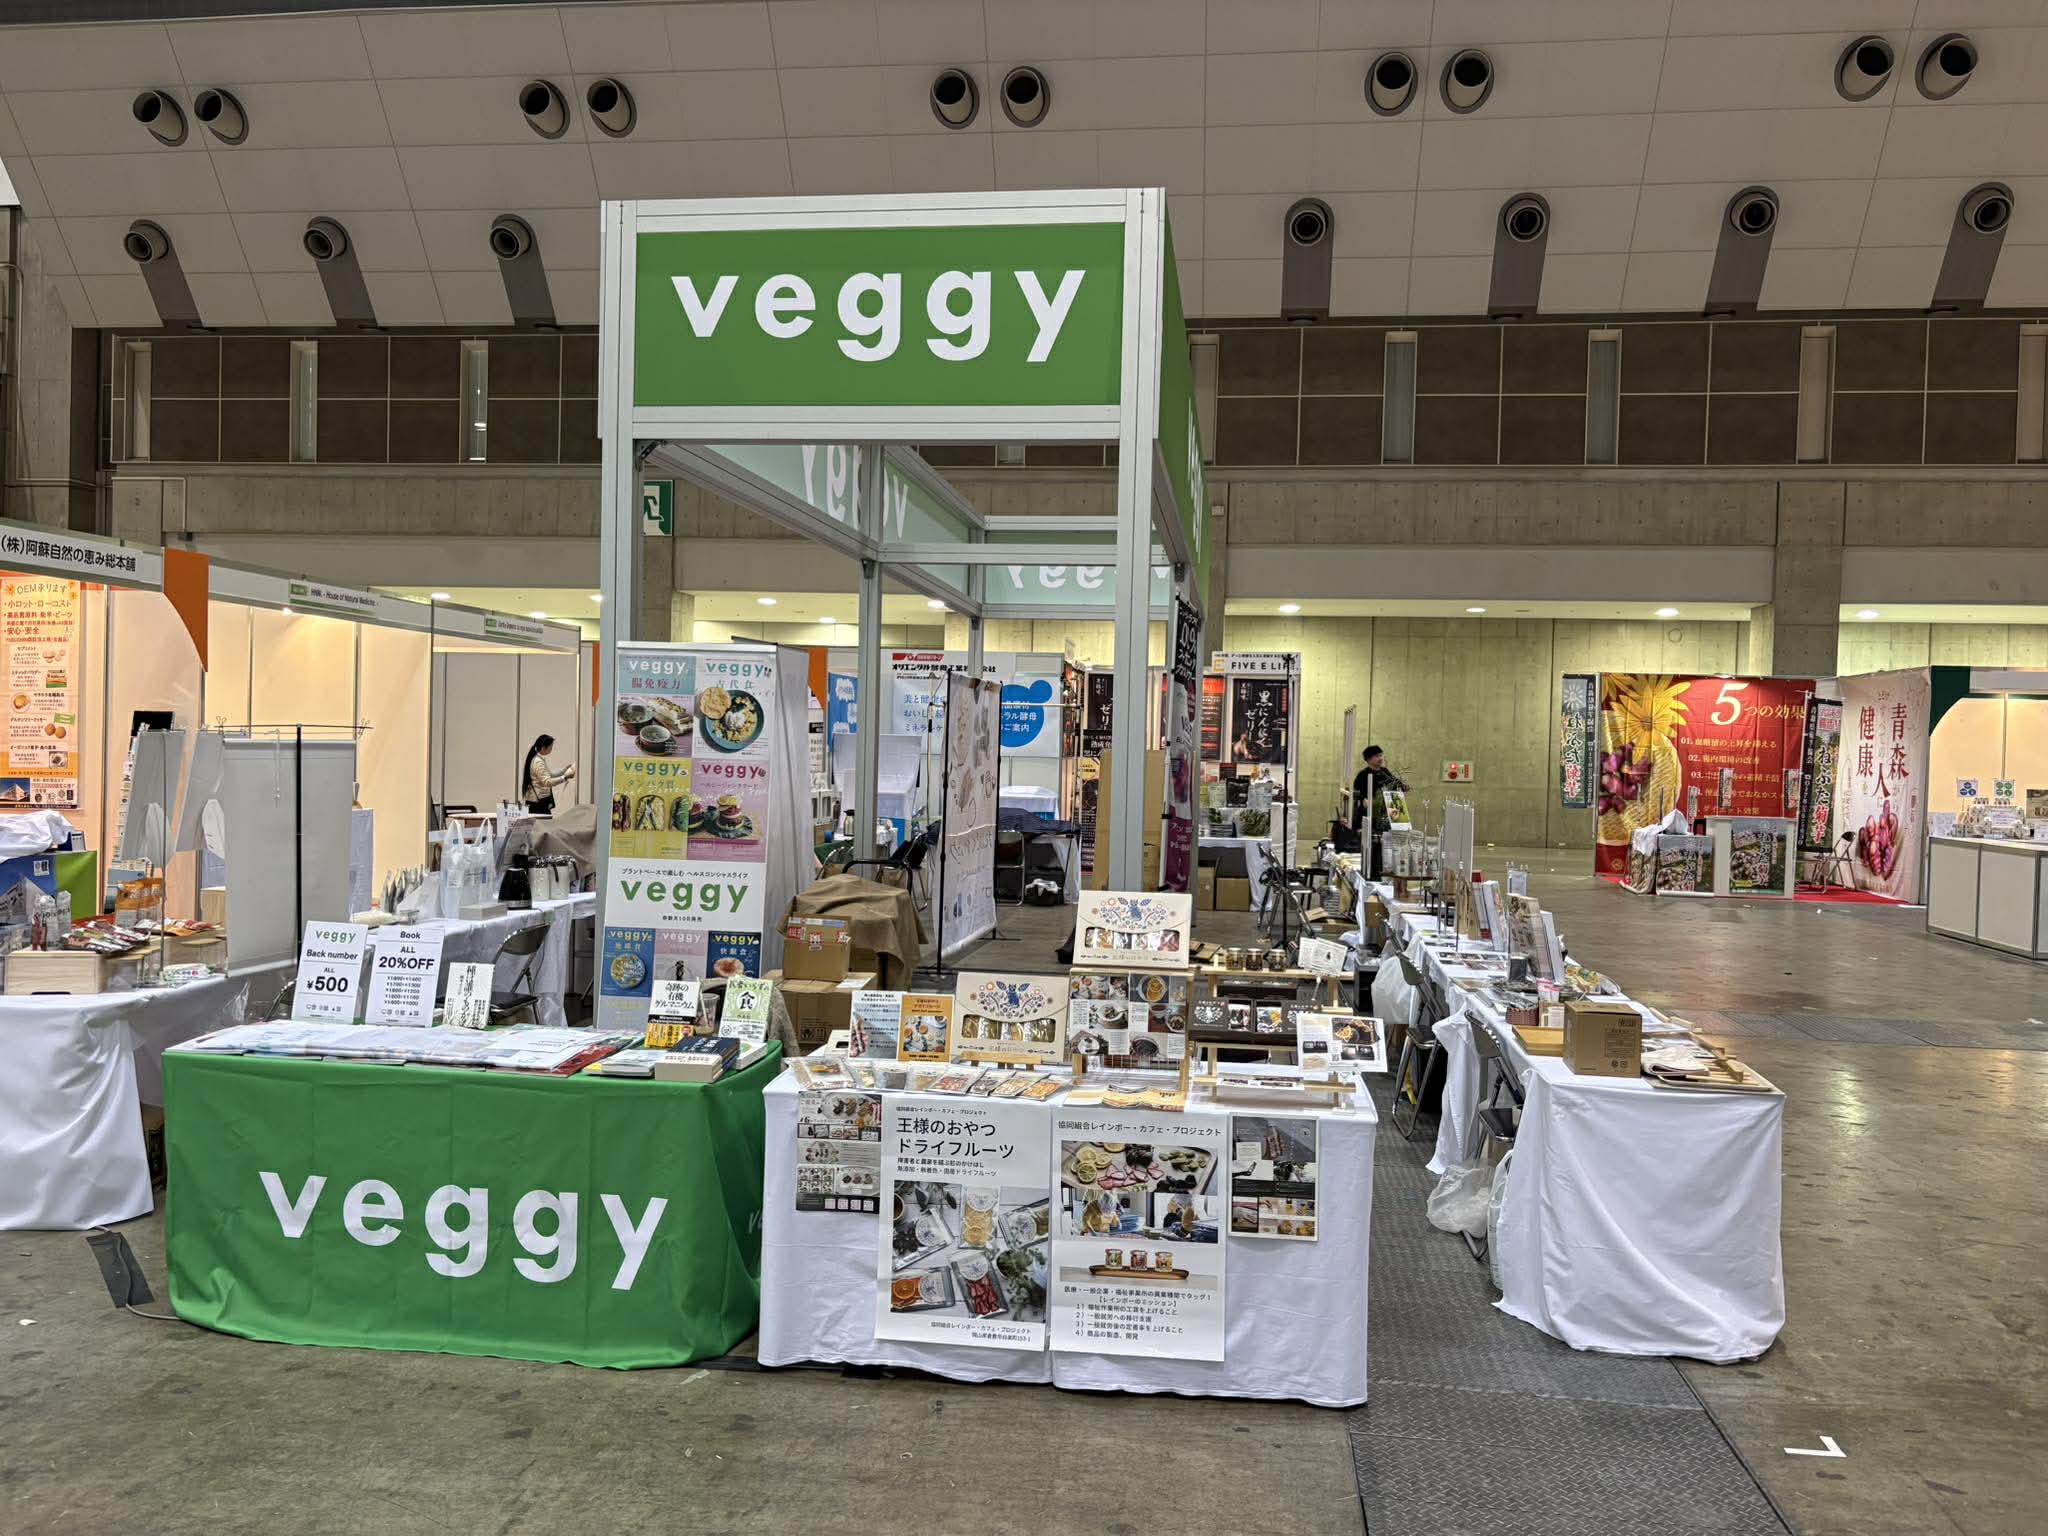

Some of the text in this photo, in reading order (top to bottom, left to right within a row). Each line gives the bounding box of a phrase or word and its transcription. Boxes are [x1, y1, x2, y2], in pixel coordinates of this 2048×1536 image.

[671, 269, 1087, 363] veggy
[629, 659, 687, 675] veggy
[706, 661, 764, 678] veggy
[1231, 662, 1256, 670] FIVE
[1261, 662, 1267, 670] E
[623, 760, 681, 776] veggy
[701, 763, 760, 779] veggy
[1808, 746, 1832, 843] ねぶた菊芋
[620, 880, 748, 913] veggy
[315, 930, 357, 943] veggy
[400, 930, 421, 939] Book
[609, 931, 648, 942] veggy
[714, 934, 754, 945] veggy
[306, 948, 359, 960] Back number
[378, 956, 435, 970] 20%OFF
[307, 975, 349, 993] ¥500
[740, 991, 755, 1010] 食
[896, 1116, 996, 1138] 王様のおやつ
[1058, 1120, 1222, 1137] 協同組合レインボー・カフェ・プロジェクト
[898, 1138, 1014, 1160] ドライフルーツ
[259, 1171, 668, 1291] veggy
